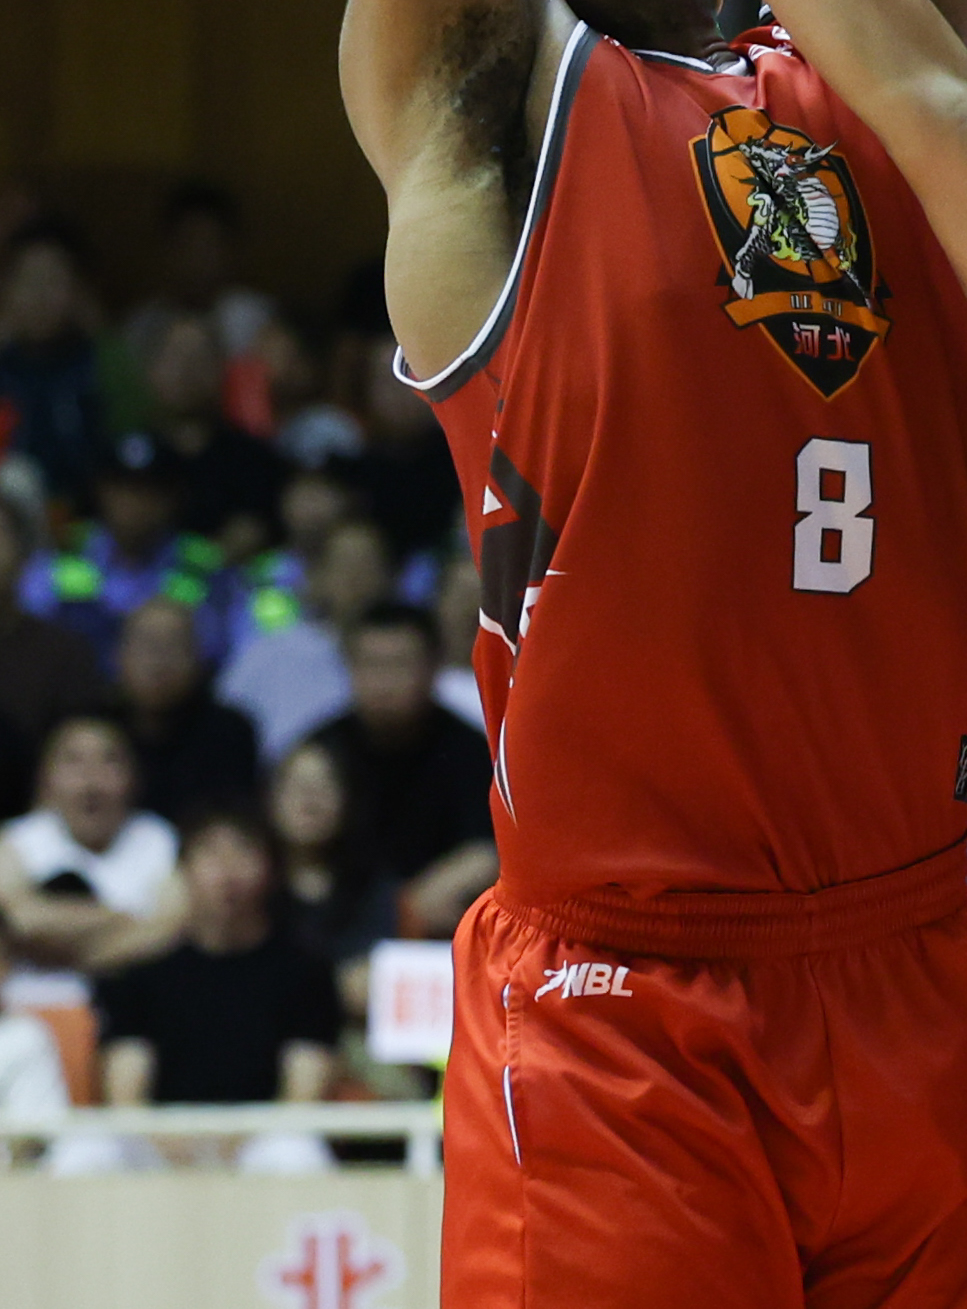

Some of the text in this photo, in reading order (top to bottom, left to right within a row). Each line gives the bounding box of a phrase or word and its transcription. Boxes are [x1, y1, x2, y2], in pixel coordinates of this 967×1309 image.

[793, 321, 856, 361] 河北
[793, 436, 876, 594] 8
[561, 961, 633, 999] NBL
